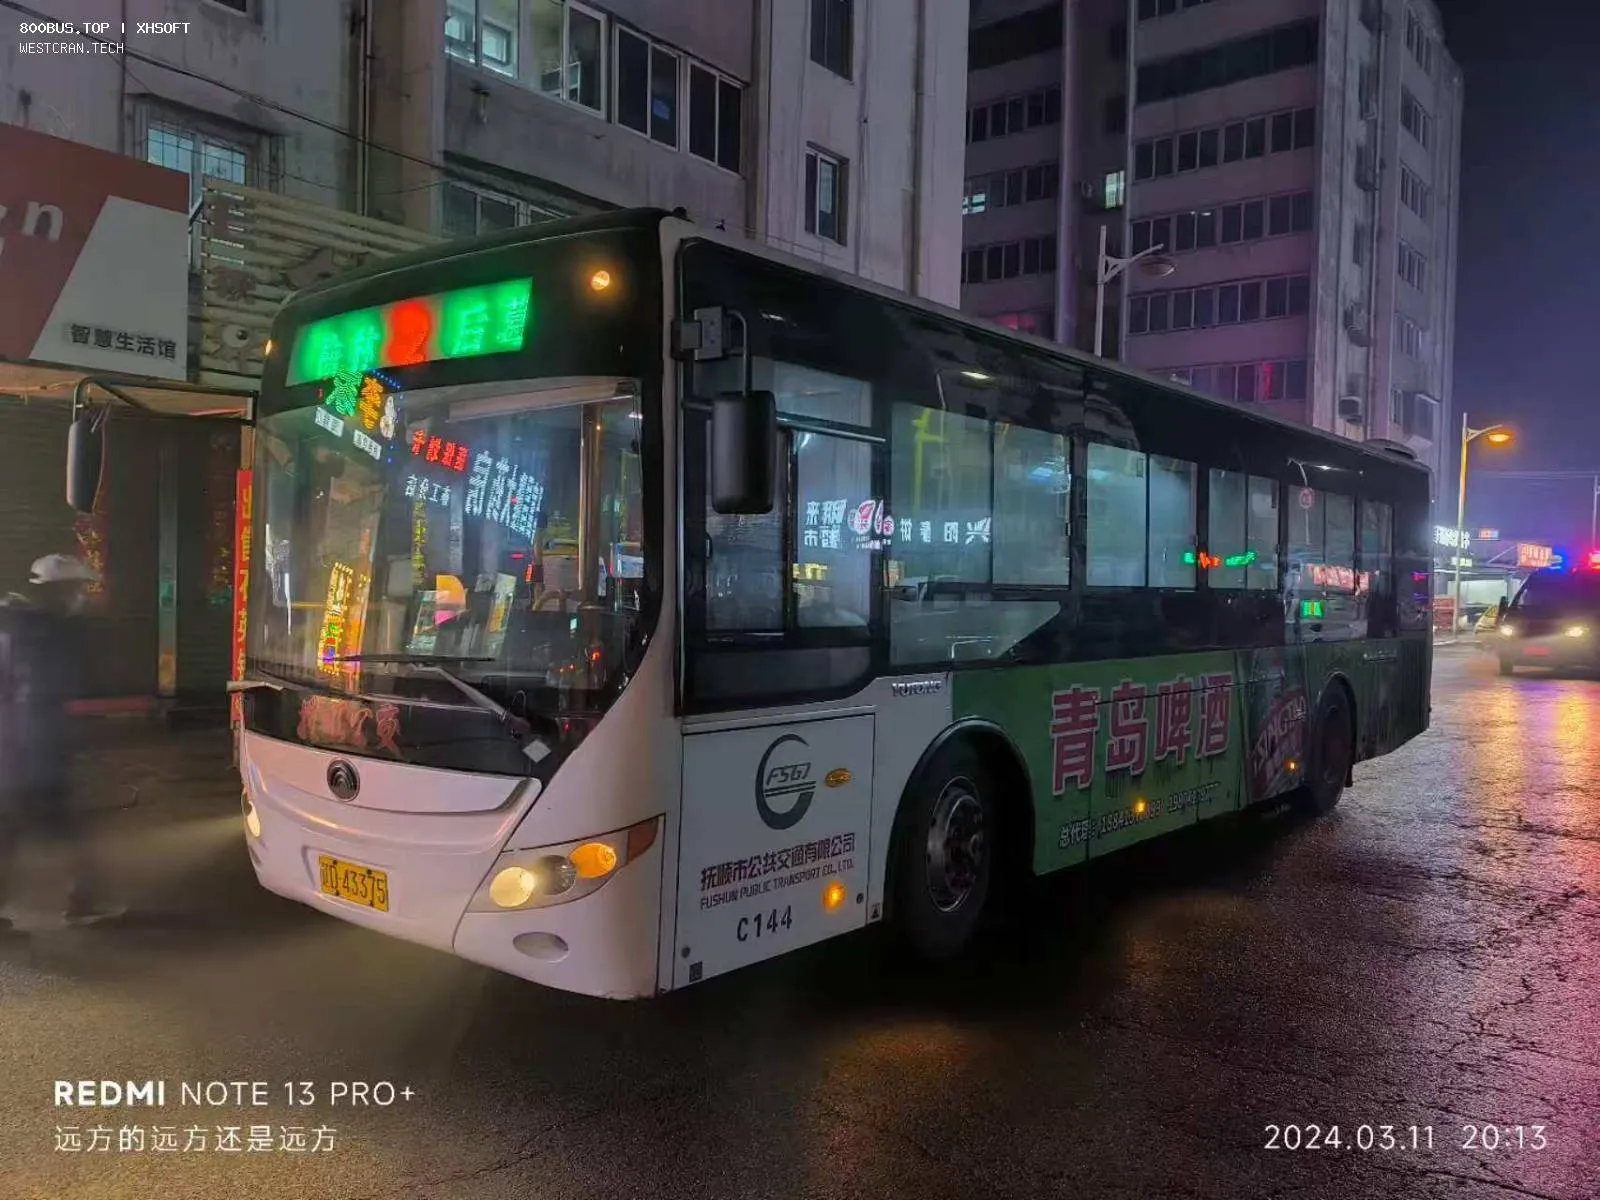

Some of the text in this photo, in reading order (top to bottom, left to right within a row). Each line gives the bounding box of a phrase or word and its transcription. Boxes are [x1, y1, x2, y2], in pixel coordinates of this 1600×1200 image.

[71, 323, 177, 360] 智慧生活馆
[1050, 672, 1234, 796] 青岛啤酒
[700, 832, 856, 891] 抚顺市公共交通有限公司
[700, 887, 738, 911] FUSHUN
[740, 880, 771, 899] PUBLIC
[774, 867, 821, 890] TRANSPORT
[737, 904, 793, 942] C144
